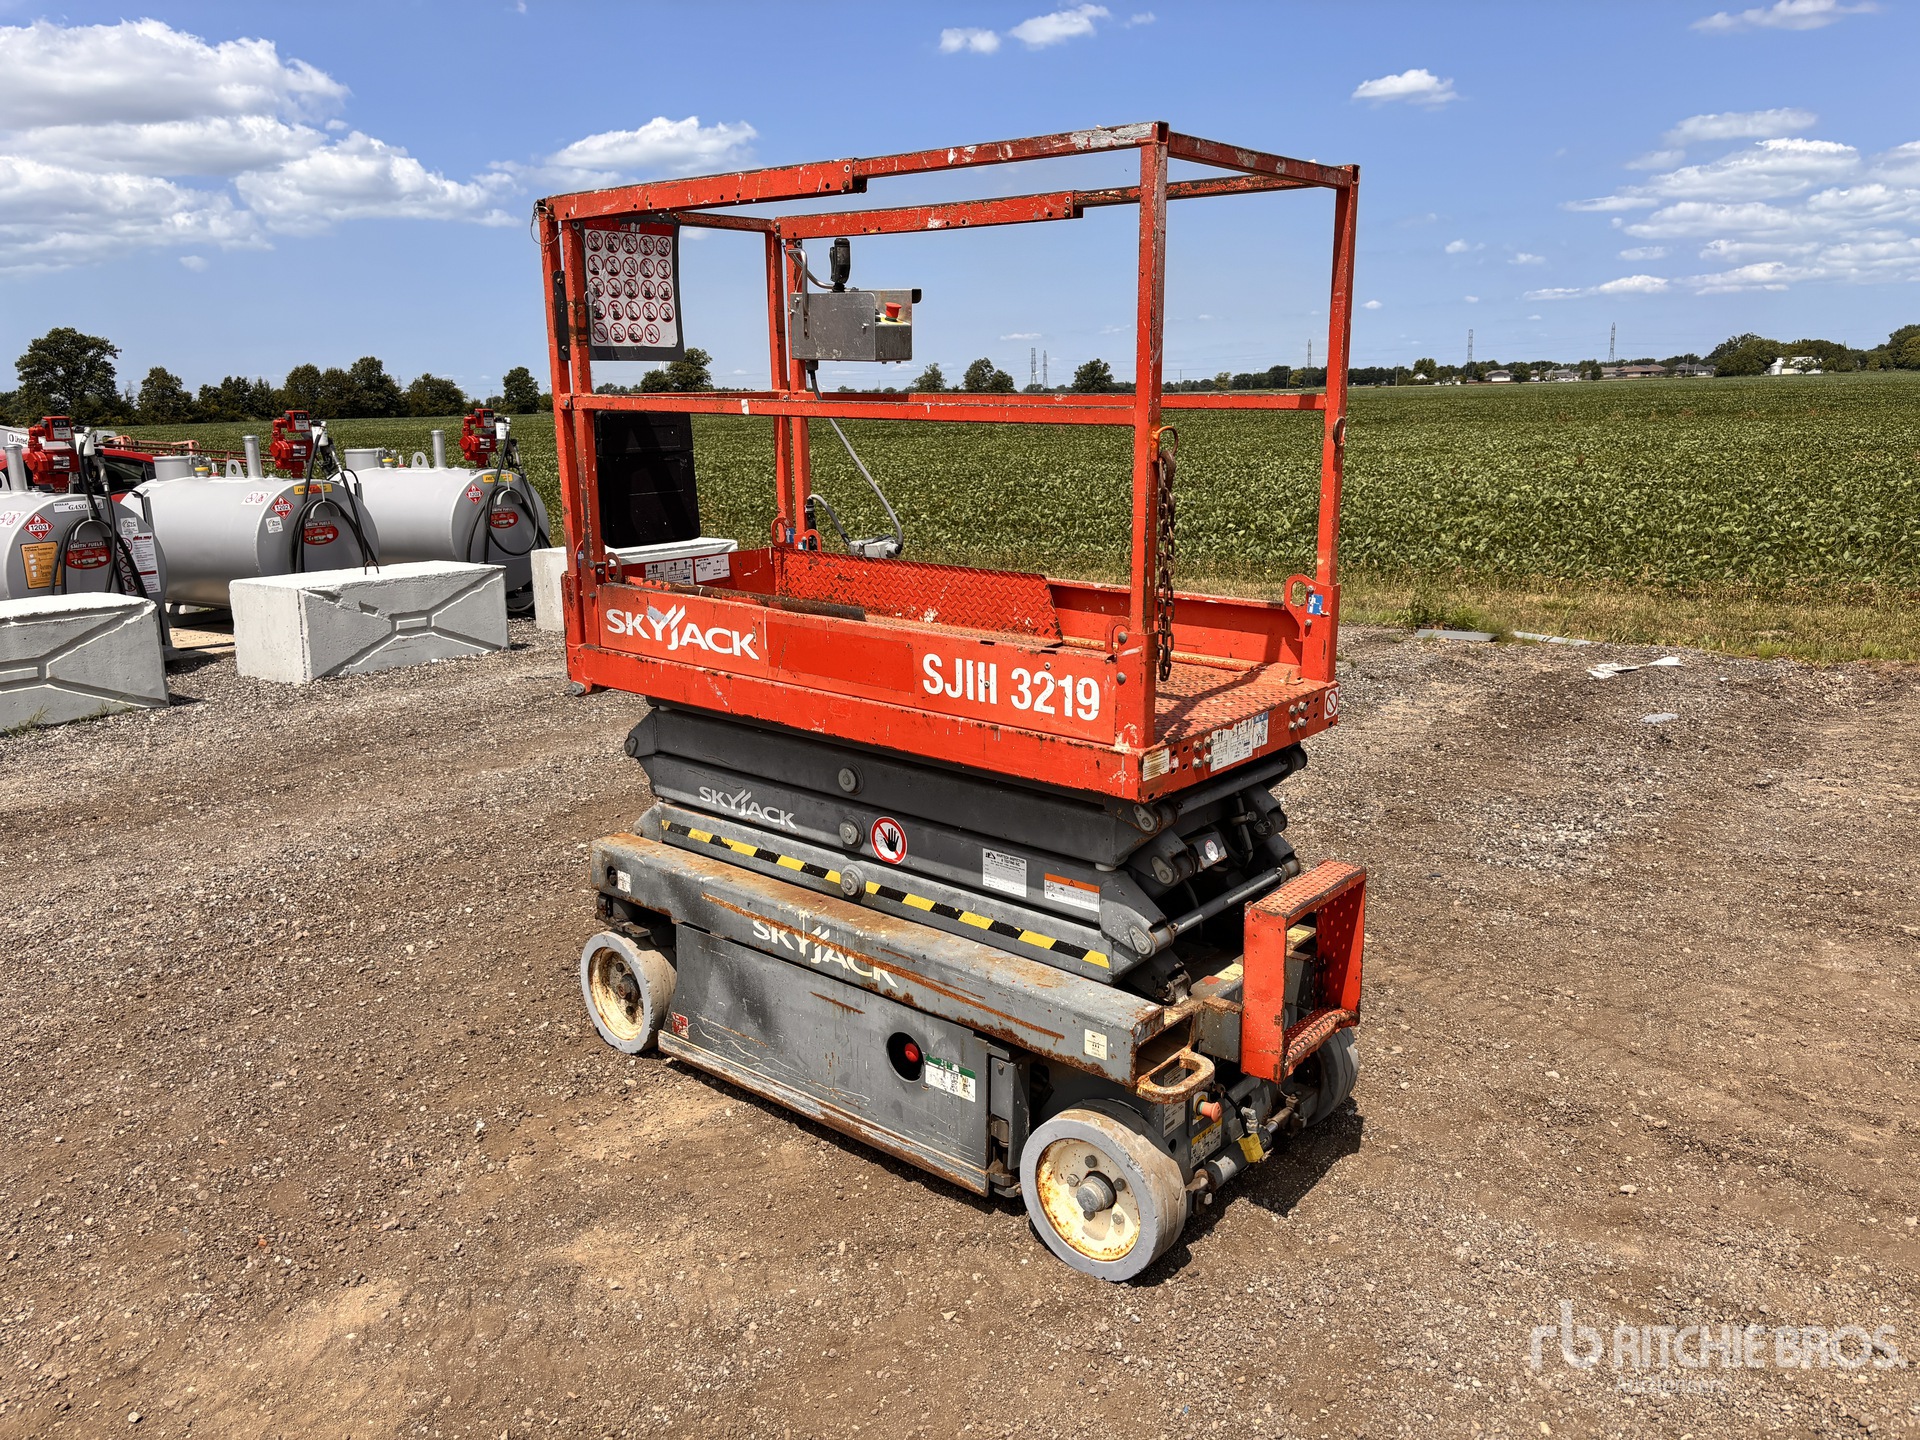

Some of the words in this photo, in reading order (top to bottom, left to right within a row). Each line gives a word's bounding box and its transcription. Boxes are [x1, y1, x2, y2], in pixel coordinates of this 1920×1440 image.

[30, 523, 48, 531] 1203
[606, 604, 760, 660] SKYJACK
[1010, 667, 1101, 721] 3219
[698, 789, 798, 829] SKYJACK
[753, 920, 899, 989] SKYJACK
